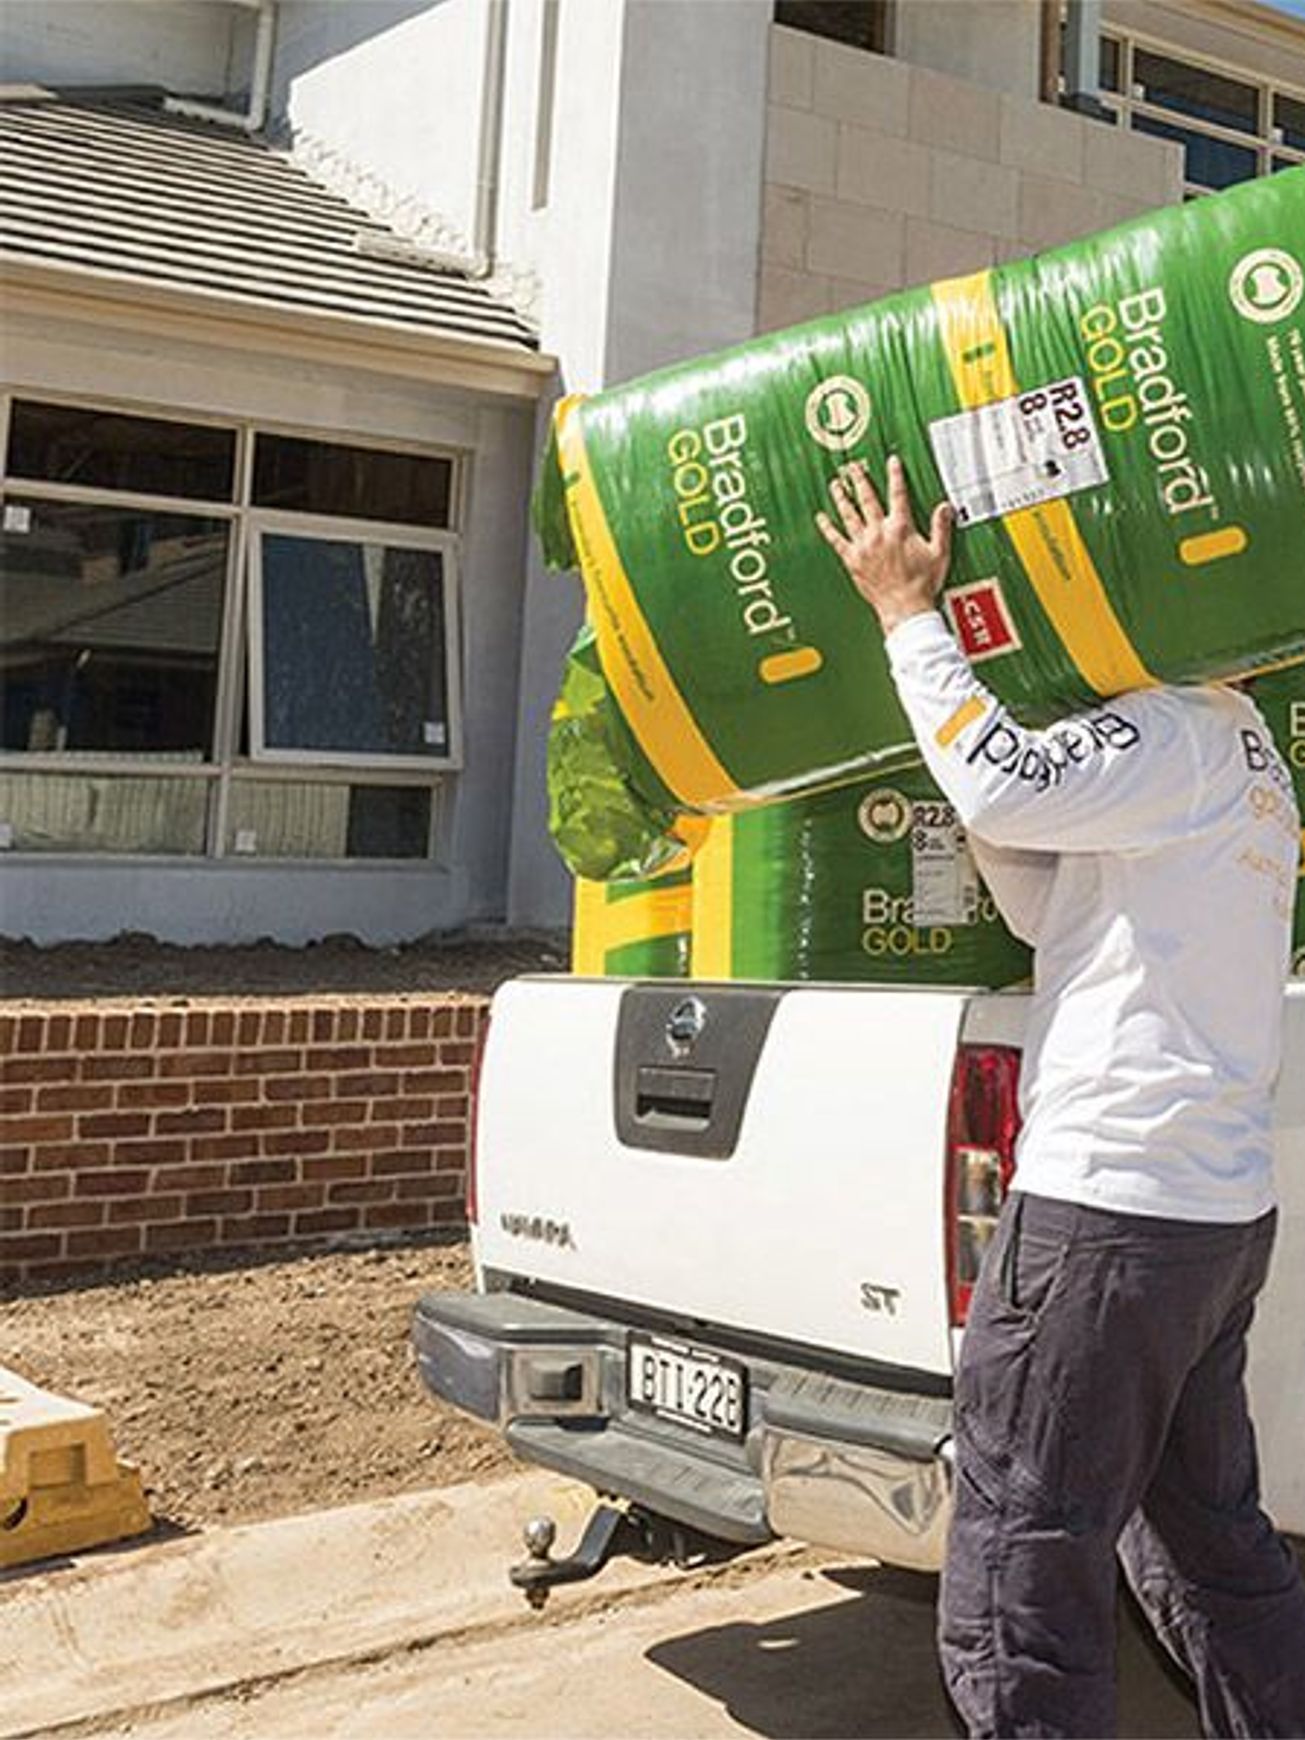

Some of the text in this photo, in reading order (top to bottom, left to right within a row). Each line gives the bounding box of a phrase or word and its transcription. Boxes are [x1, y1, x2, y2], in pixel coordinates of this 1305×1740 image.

[1019, 392, 1047, 416] 8
[1080, 304, 1138, 431] GOLD
[1118, 287, 1215, 514] Bradford
[668, 429, 720, 555] GOLD
[703, 414, 791, 635] Bradford
[862, 926, 953, 956] GOLD
[860, 1282, 901, 1317] ST
